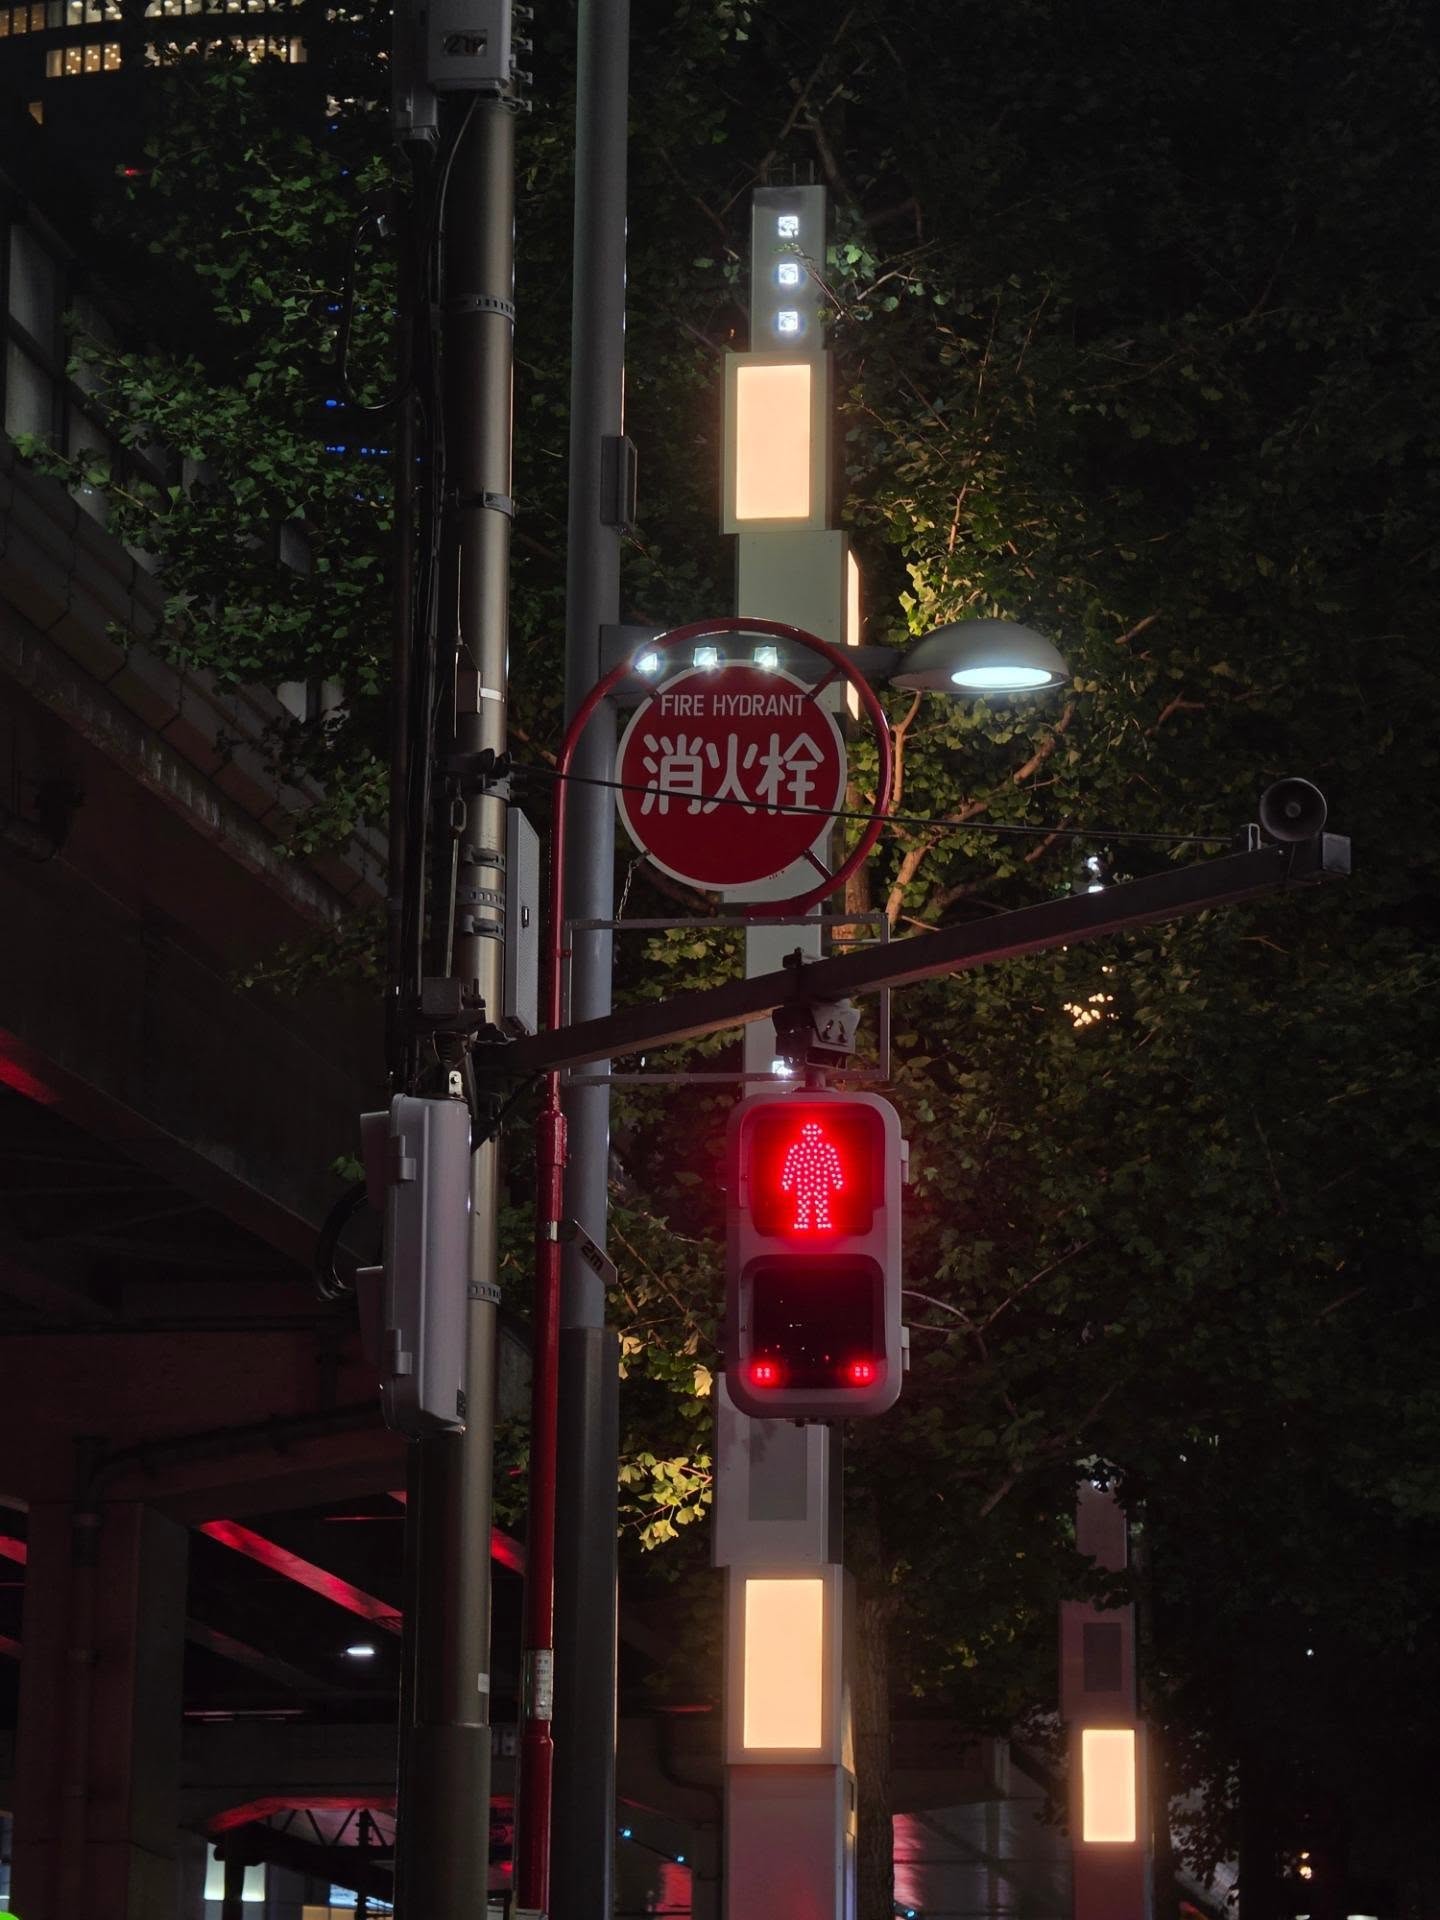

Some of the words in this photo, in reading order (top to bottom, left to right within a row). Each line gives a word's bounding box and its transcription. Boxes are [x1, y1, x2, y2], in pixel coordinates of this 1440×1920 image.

[661, 694, 704, 716] FIRE
[712, 694, 806, 716] HYDRANT
[640, 732, 825, 815] 消火栓
